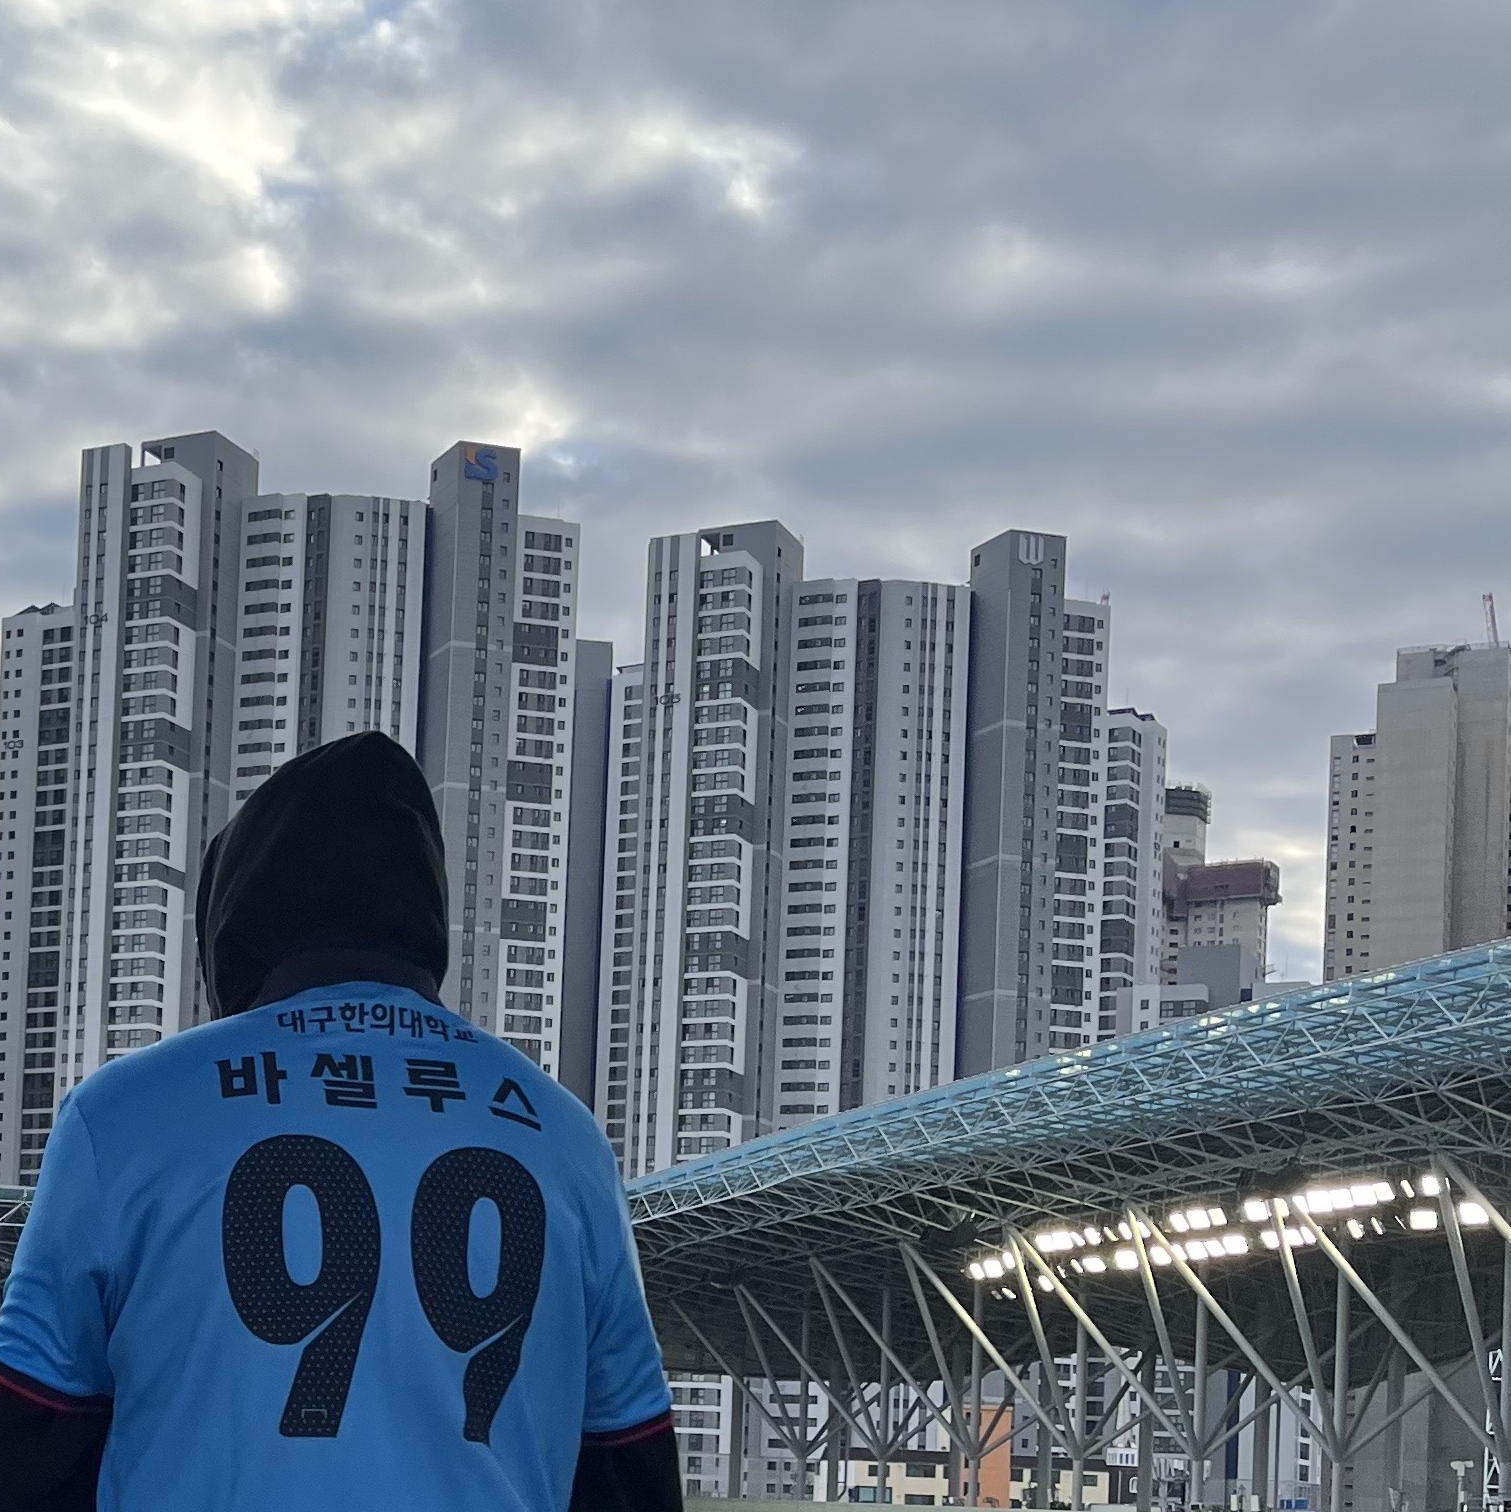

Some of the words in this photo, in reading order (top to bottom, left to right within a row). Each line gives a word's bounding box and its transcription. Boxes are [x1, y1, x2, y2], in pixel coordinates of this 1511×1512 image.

[3, 740, 24, 750] 103
[277, 1001, 479, 1044] 대구한의대학교
[222, 1133, 547, 1448] 99
